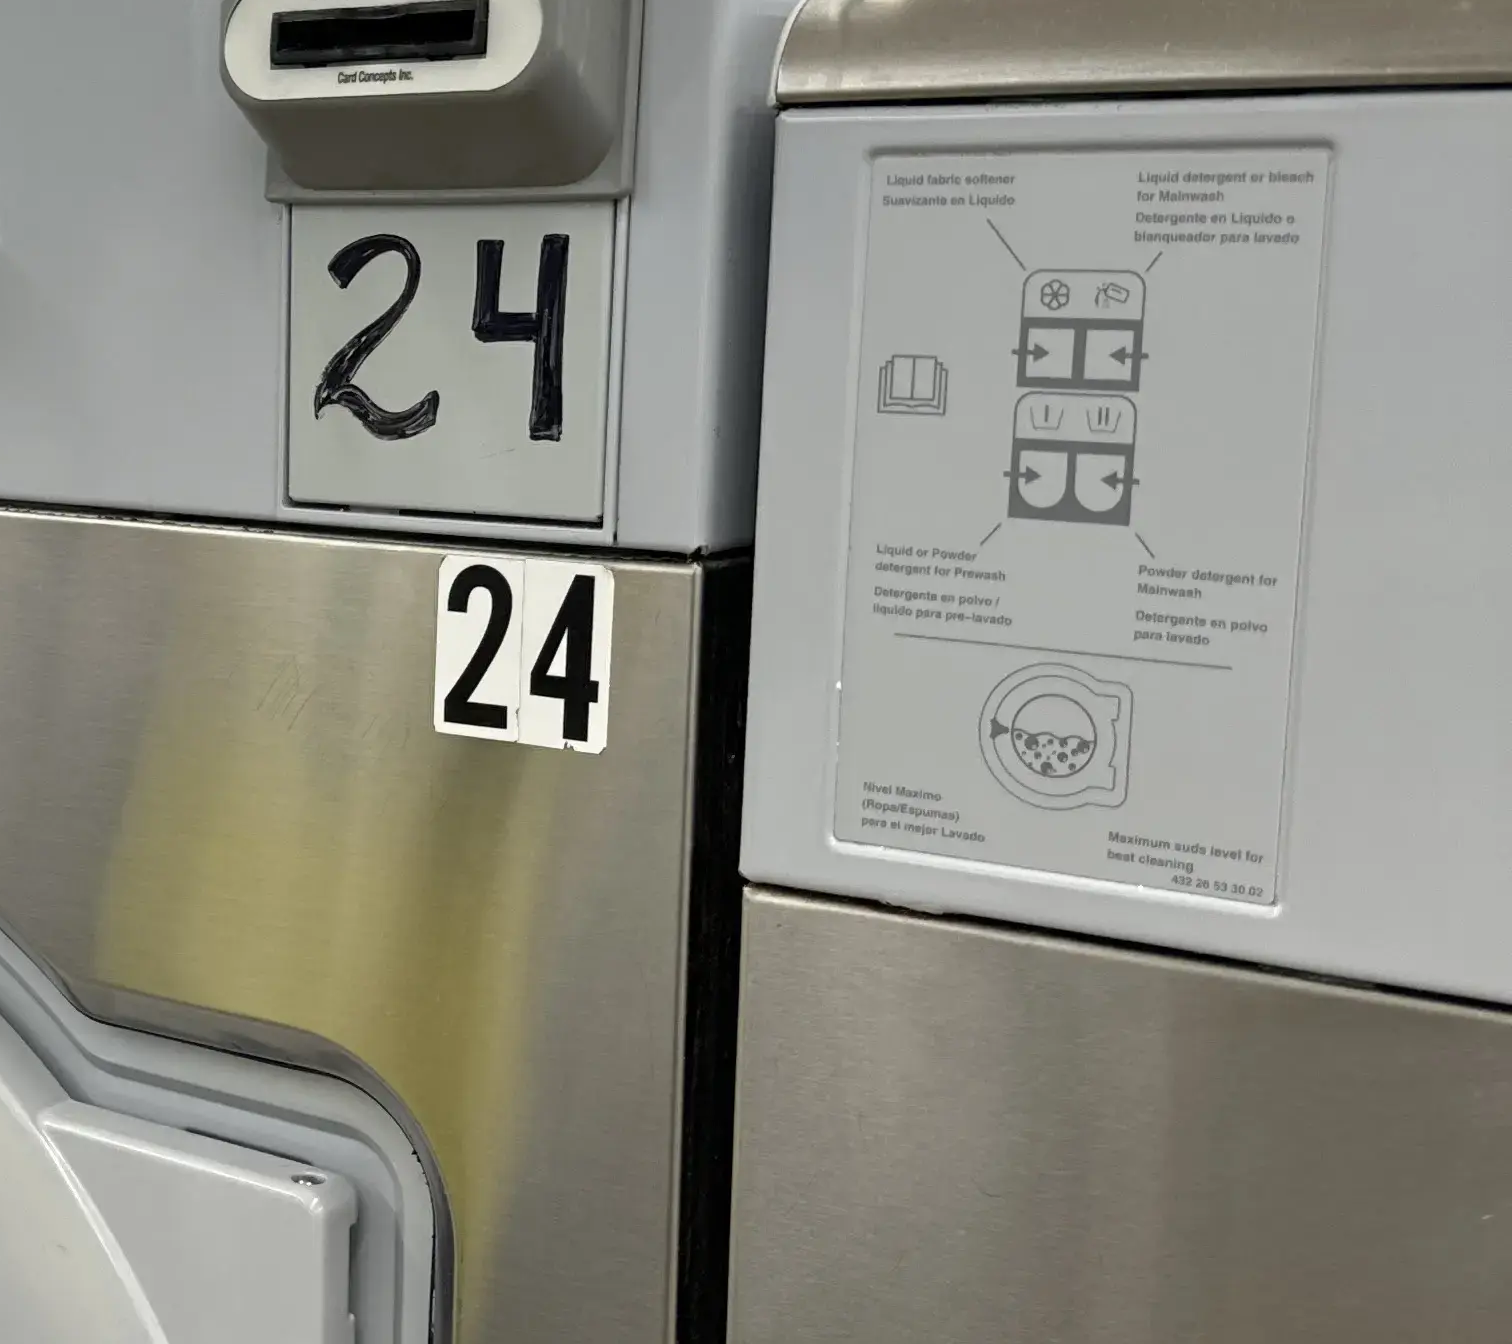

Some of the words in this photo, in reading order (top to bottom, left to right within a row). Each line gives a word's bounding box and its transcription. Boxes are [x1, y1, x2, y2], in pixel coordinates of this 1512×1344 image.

[338, 71, 357, 84] Card
[359, 69, 397, 84] Concepts
[399, 69, 414, 81] Inc.
[887, 174, 924, 187] Liquid
[928, 174, 961, 185] fabric
[965, 174, 1015, 185] softener
[1138, 172, 1179, 185] Liquid
[1182, 172, 1246, 185] detergent
[1250, 173, 1264, 183] or
[1268, 171, 1314, 183] bleach
[883, 196, 947, 206] Suavizante
[950, 197, 965, 206] en
[969, 193, 1015, 207] Liquido
[1137, 191, 1154, 202] for
[1159, 190, 1224, 202] Mainwash
[1135, 212, 1206, 225] Detergente
[1210, 214, 1226, 224] en
[1231, 212, 1282, 226] Liquido
[1286, 215, 1295, 224] o
[1134, 230, 1216, 244] blanqueador
[1220, 233, 1249, 245] para
[1254, 232, 1300, 244] lavado
[314, 233, 570, 442] 24
[876, 544, 913, 558] Liquid
[916, 548, 929, 558] or
[932, 548, 978, 562] Powder
[875, 562, 931, 576] detergent
[934, 565, 951, 576] for
[954, 567, 1006, 581] Prewash
[1138, 564, 1188, 579] Powder
[1191, 569, 1255, 585] detergent
[1259, 574, 1277, 587] for
[874, 586, 937, 602] Detergente
[940, 594, 955, 603] en
[959, 595, 992, 606] polvo
[1137, 583, 1202, 598] Mainwash
[873, 603, 913, 616] liquido
[915, 608, 942, 619] para
[945, 611, 1013, 626] pre-lavado
[1136, 610, 1207, 627] Detergente
[1210, 620, 1226, 629] en
[1230, 620, 1268, 633] polvo
[1133, 630, 1162, 641] para
[1166, 632, 1210, 645] lavado
[443, 564, 599, 742] 24
[863, 781, 892, 795] Nivel
[896, 786, 942, 801] Maximo
[862, 798, 960, 823] (Ropa/Espumas)
[861, 817, 887, 827] para
[890, 820, 901, 829] el
[904, 823, 938, 836] mejor
[942, 827, 986, 843] Lavado
[1108, 831, 1171, 850] Maximum
[1174, 842, 1207, 856] suds
[1210, 846, 1242, 861] level
[1246, 850, 1264, 864] for
[1107, 848, 1135, 862] best
[1138, 854, 1194, 874] cleaning
[1171, 874, 1192, 887] 432
[1214, 881, 1228, 892] 53
[1231, 883, 1246, 895] 30
[1248, 886, 1263, 898] 02
